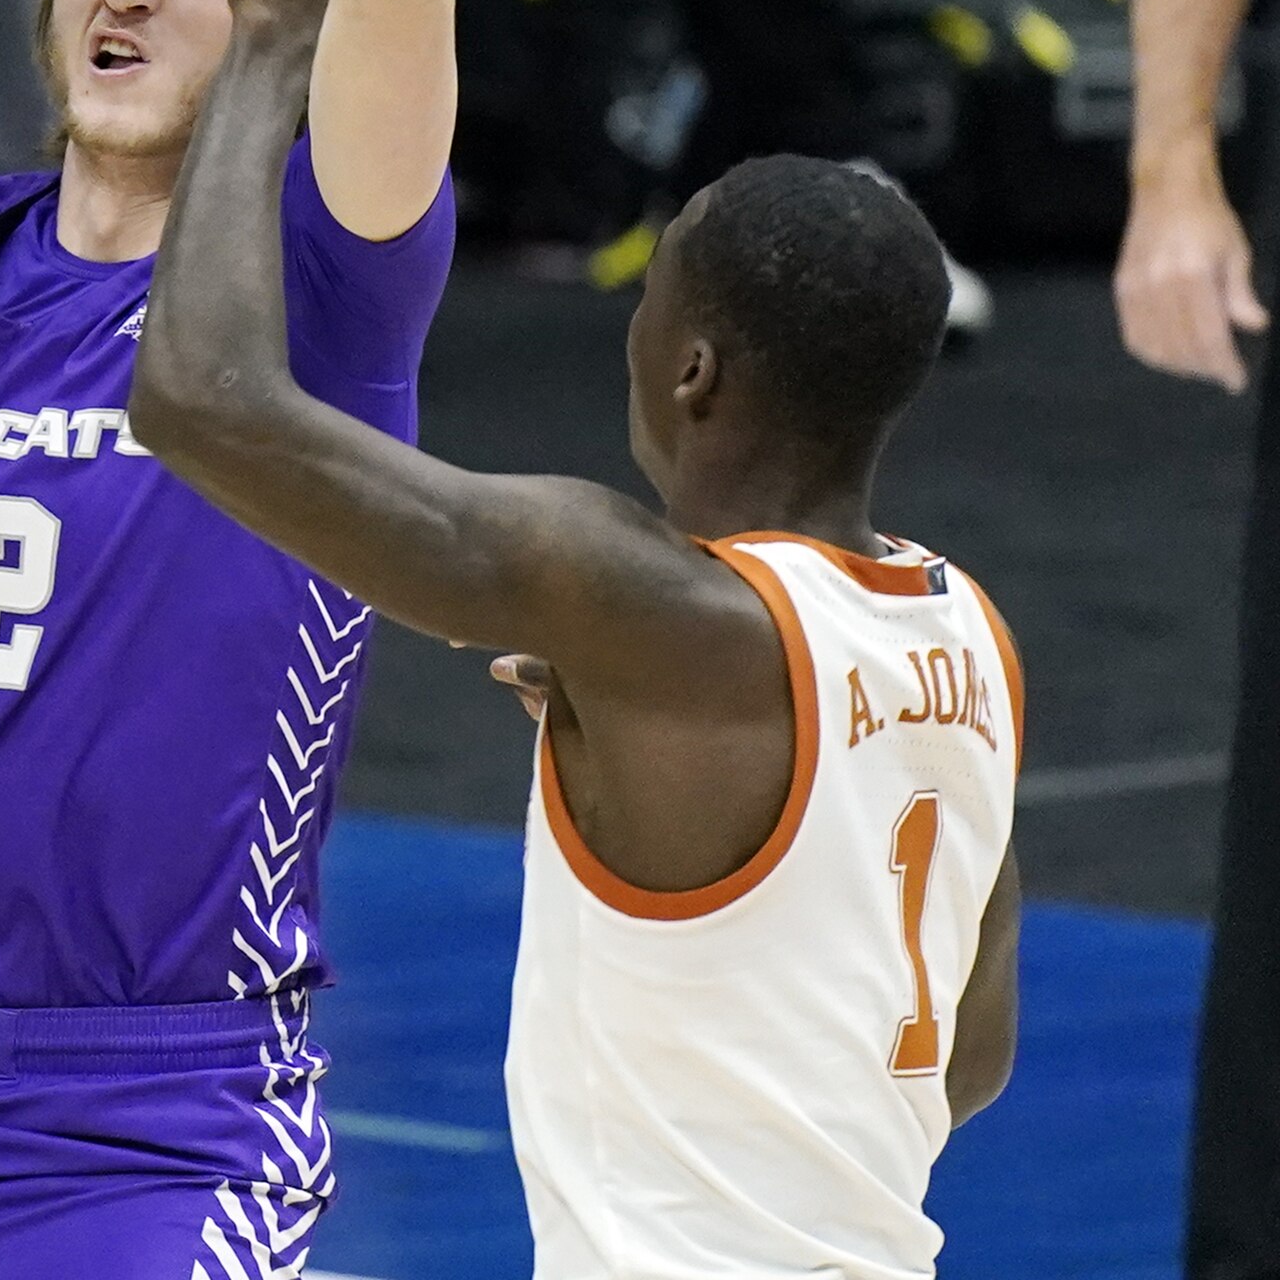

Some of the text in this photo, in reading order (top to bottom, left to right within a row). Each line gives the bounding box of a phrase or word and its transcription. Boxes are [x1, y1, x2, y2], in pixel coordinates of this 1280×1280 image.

[847, 647, 998, 753] A. JON
[888, 788, 944, 1078] 1
